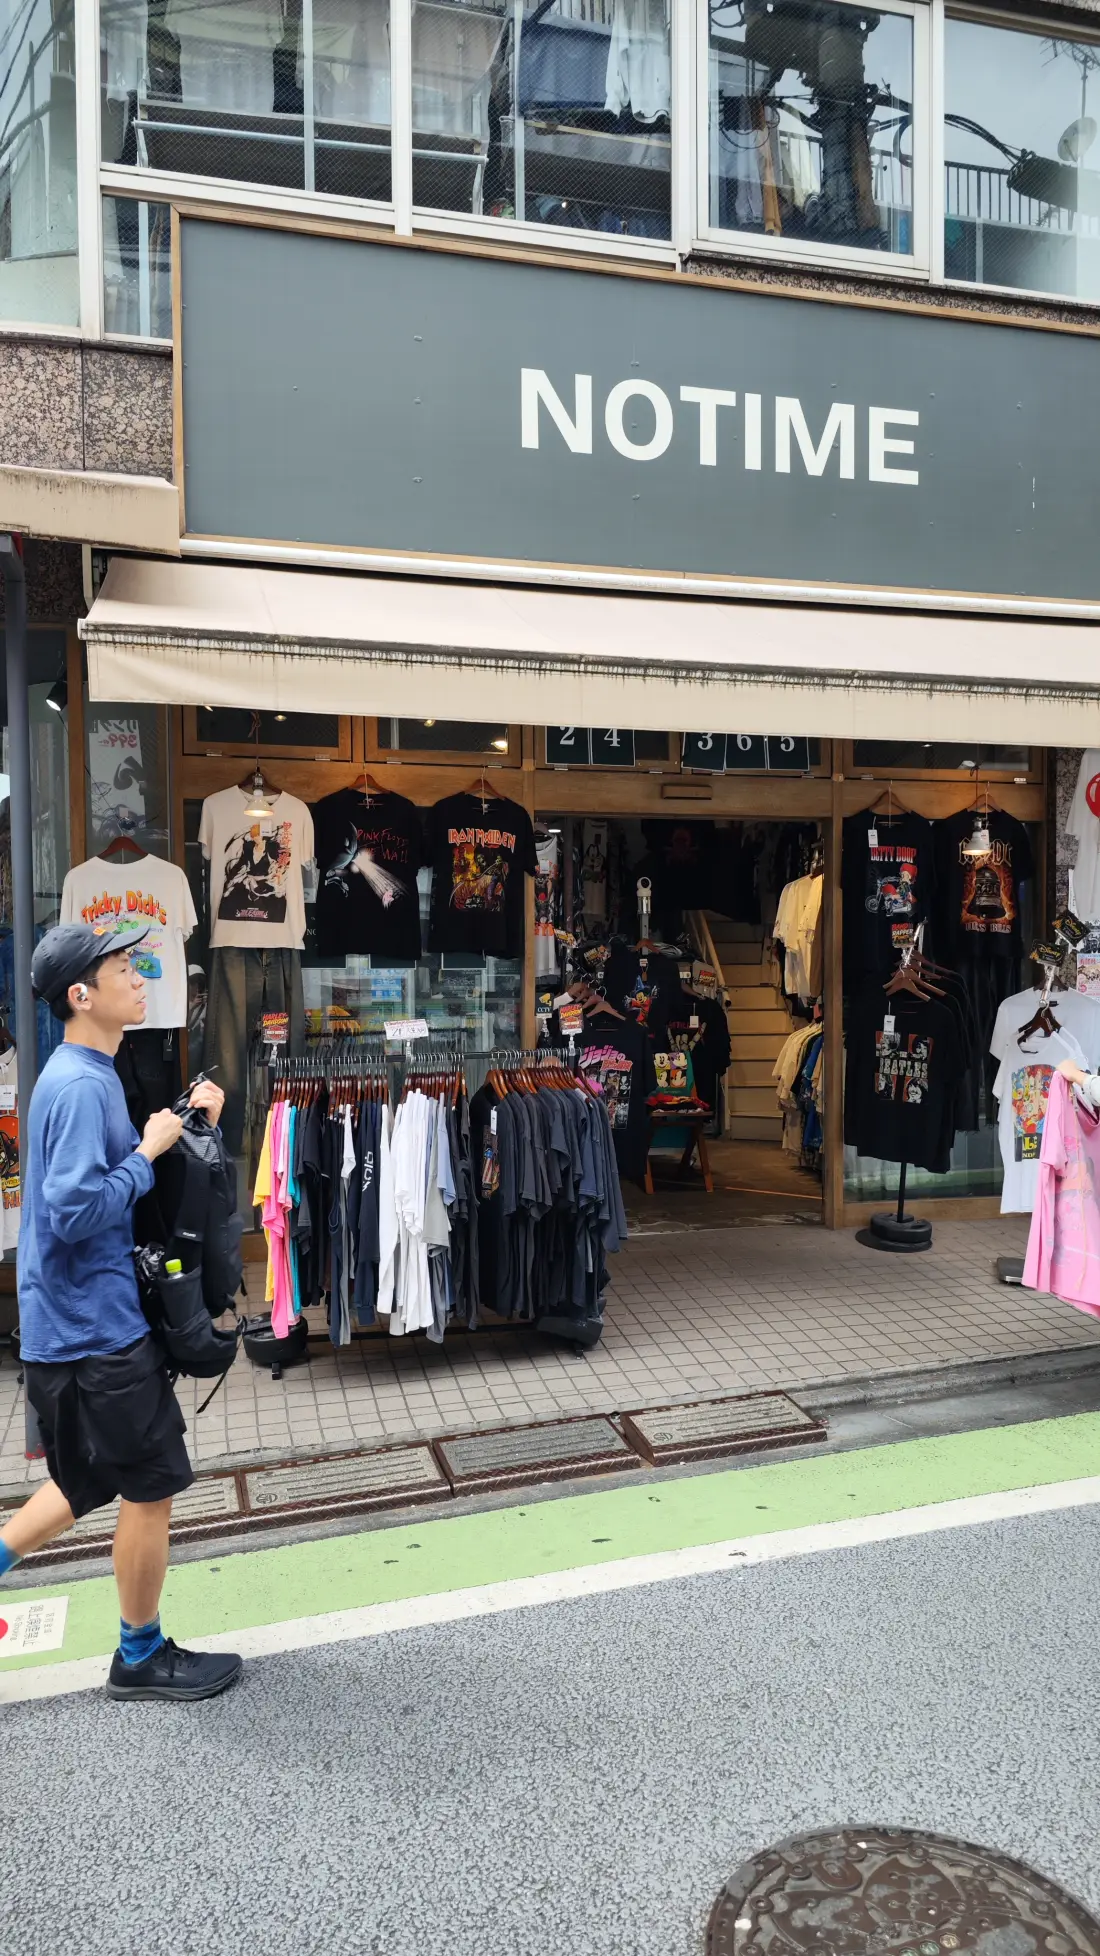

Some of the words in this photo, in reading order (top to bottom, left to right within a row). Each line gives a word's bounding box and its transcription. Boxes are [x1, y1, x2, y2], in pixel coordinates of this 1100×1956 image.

[520, 367, 920, 486] NOTIME
[357, 828, 380, 840] PINK
[447, 827, 475, 847] IRON
[474, 828, 516, 854] MAIDEN
[870, 845, 895, 862] BETTY
[895, 846, 917, 863] BOOP
[81, 890, 122, 924] Tricky
[126, 890, 167, 926] Dick's
[892, 928, 914, 937] RAPPER
[262, 1012, 288, 1021] HARLEY-
